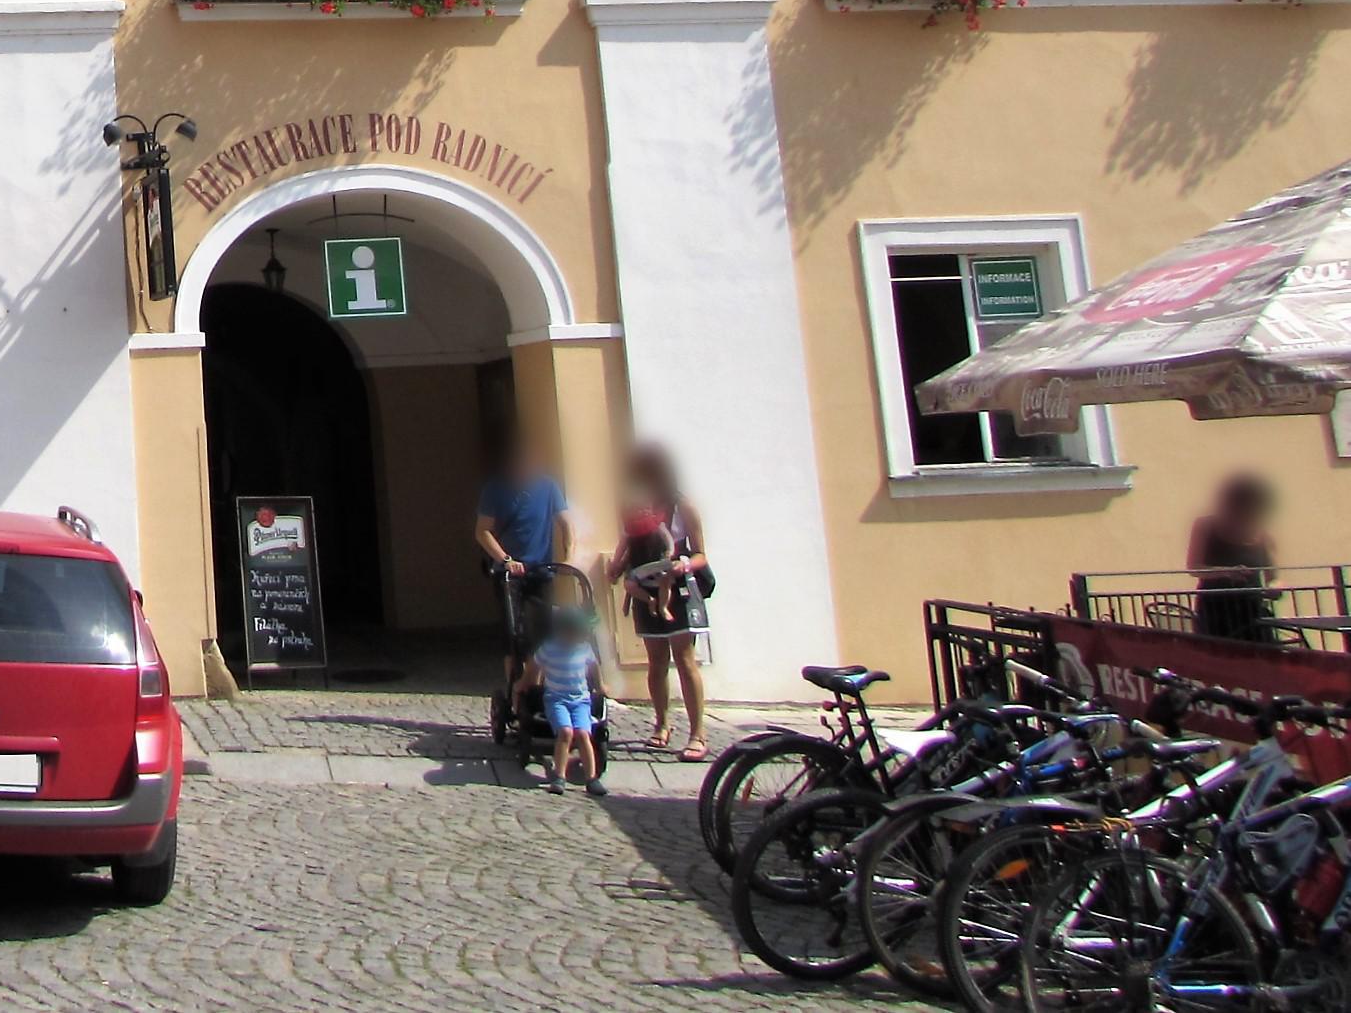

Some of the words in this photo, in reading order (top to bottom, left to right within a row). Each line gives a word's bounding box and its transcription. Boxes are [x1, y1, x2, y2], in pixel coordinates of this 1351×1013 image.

[184, 114, 357, 213] RESTAURACE
[368, 113, 421, 155] POD
[431, 121, 553, 204] RADNICÍ
[978, 272, 1032, 283] INFORMACE
[980, 296, 1035, 305] INFORMATION
